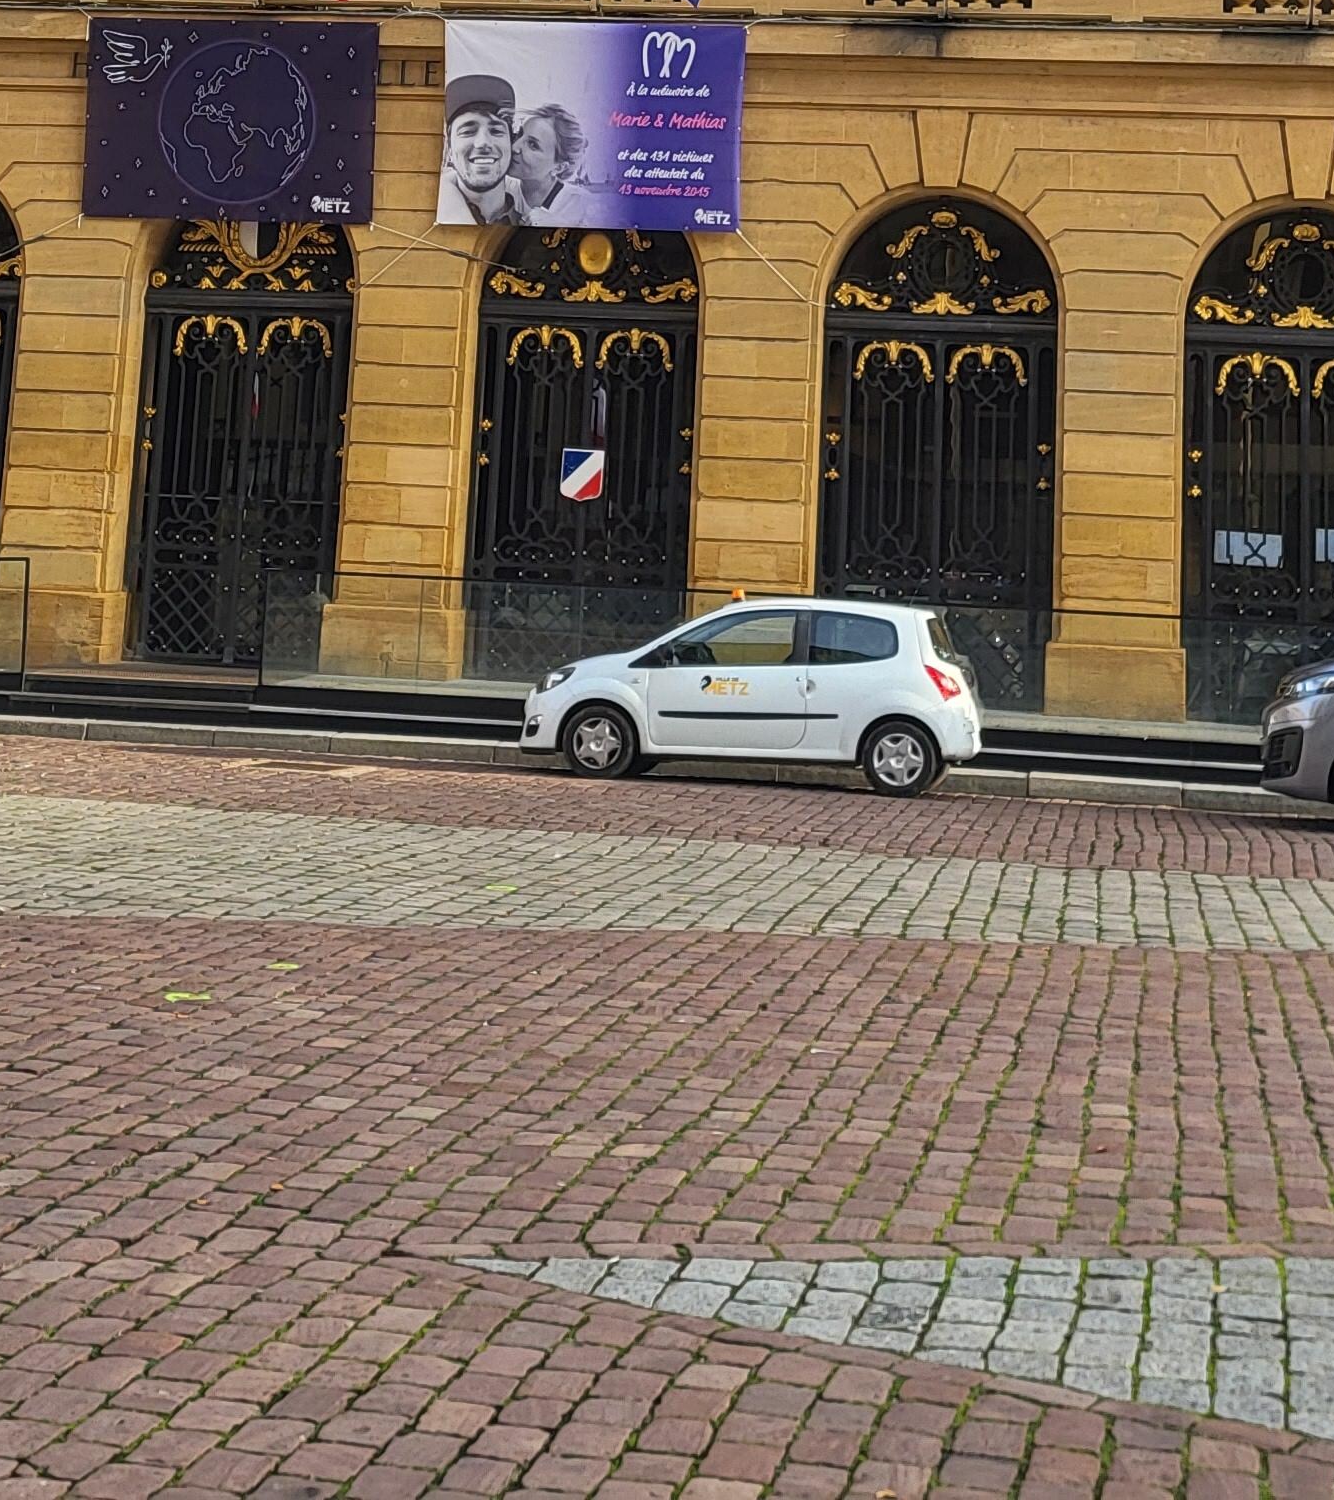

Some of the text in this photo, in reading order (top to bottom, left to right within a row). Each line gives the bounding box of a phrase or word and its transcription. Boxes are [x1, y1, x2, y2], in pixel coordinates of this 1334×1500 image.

[627, 81, 710, 97] À la mémoire de
[609, 111, 727, 129] Marie & Mathias
[617, 149, 629, 160] et
[629, 148, 648, 161] des
[672, 150, 714, 163] victimes
[624, 165, 705, 180] des attentats du
[618, 183, 711, 197] 13 novembre 2015
[312, 200, 351, 213] METZ
[696, 213, 731, 225] METZ
[704, 682, 750, 696] METZ
